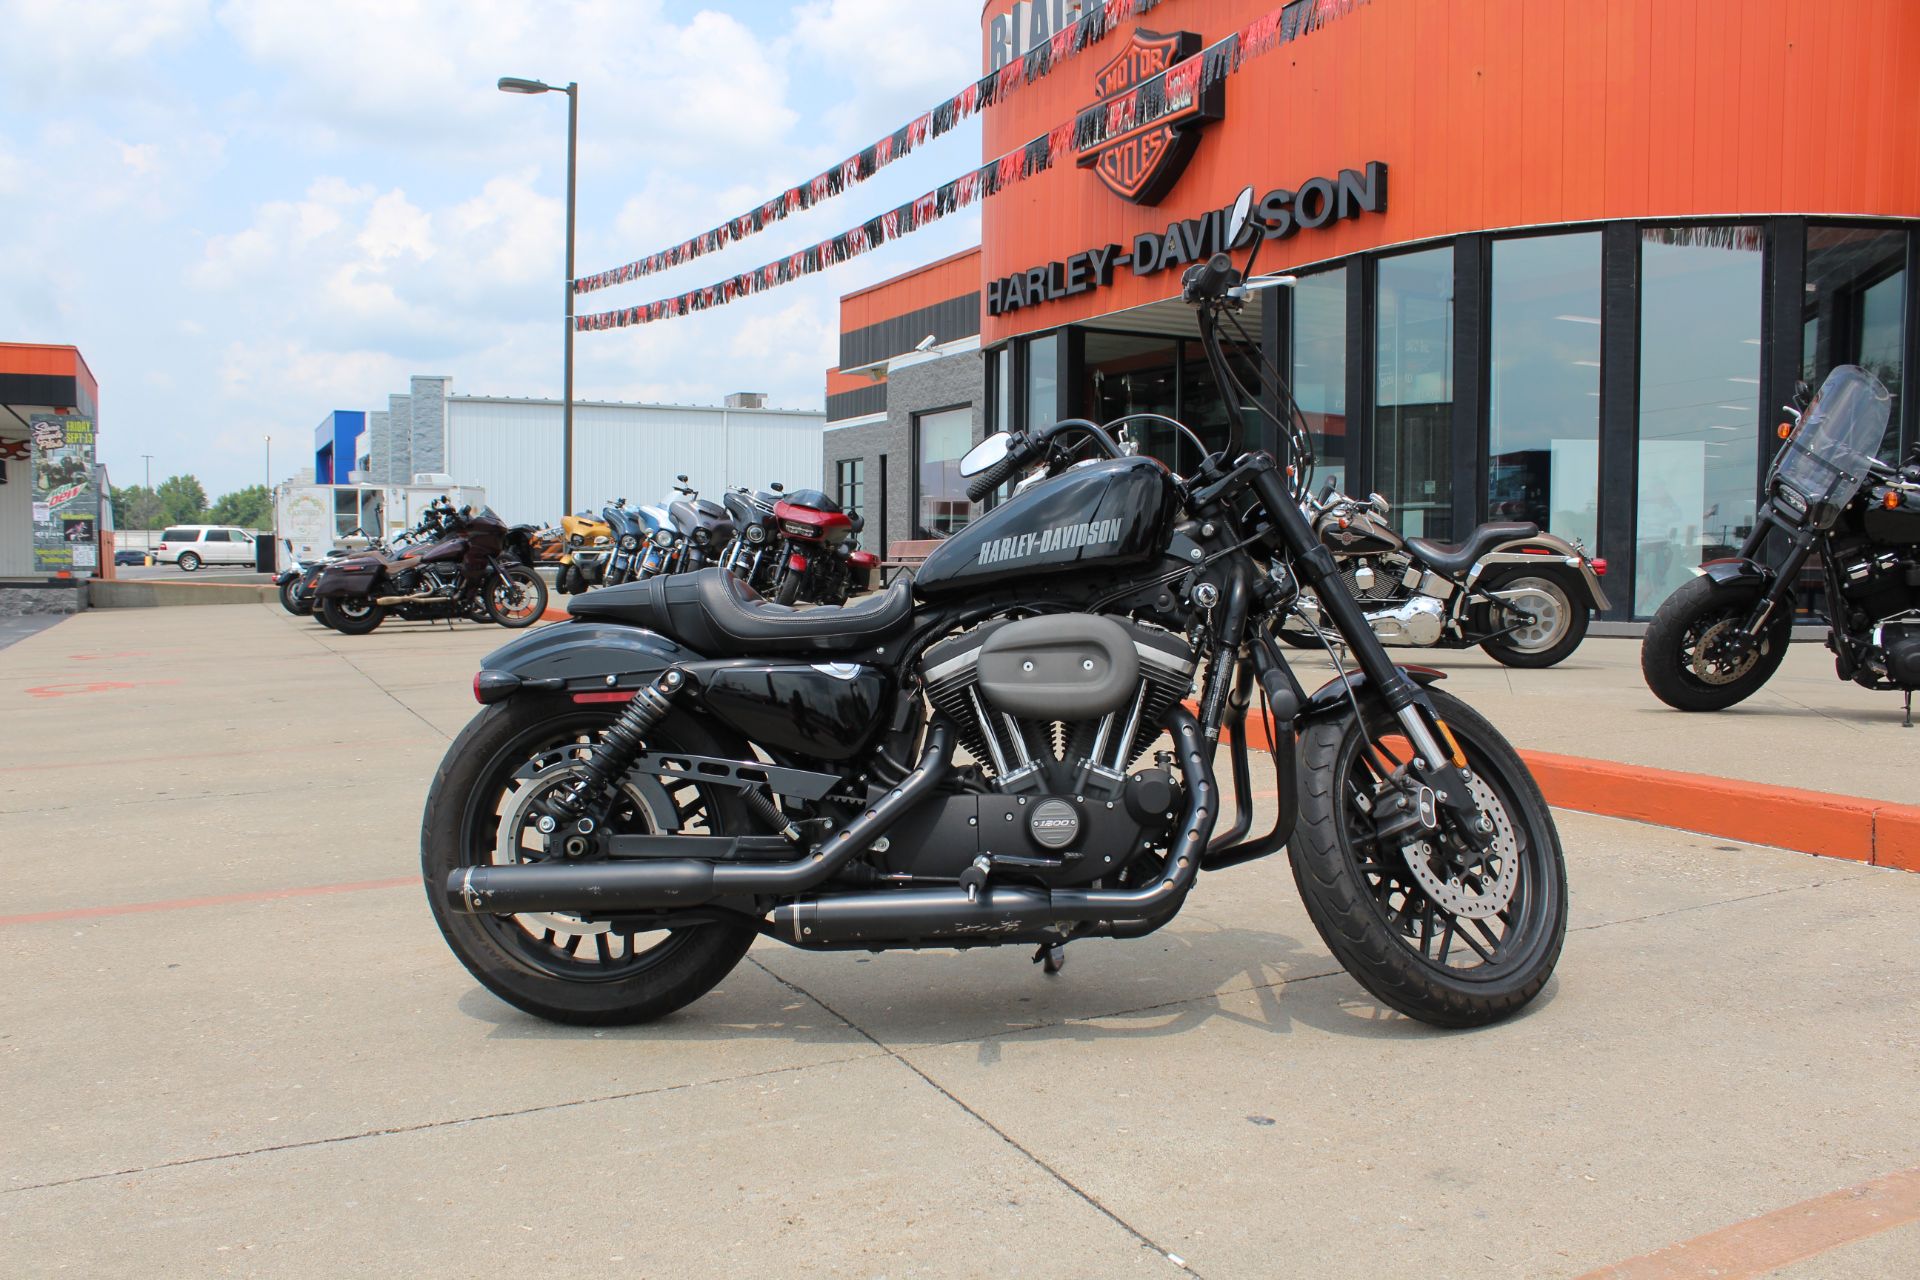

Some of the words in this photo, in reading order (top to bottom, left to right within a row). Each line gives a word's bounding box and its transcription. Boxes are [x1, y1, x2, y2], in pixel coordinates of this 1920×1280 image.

[1105, 45, 1165, 95] MOTOR
[1104, 129, 1162, 187] CYCLES
[978, 517, 1122, 565] HARLEY-DAVIDSON
